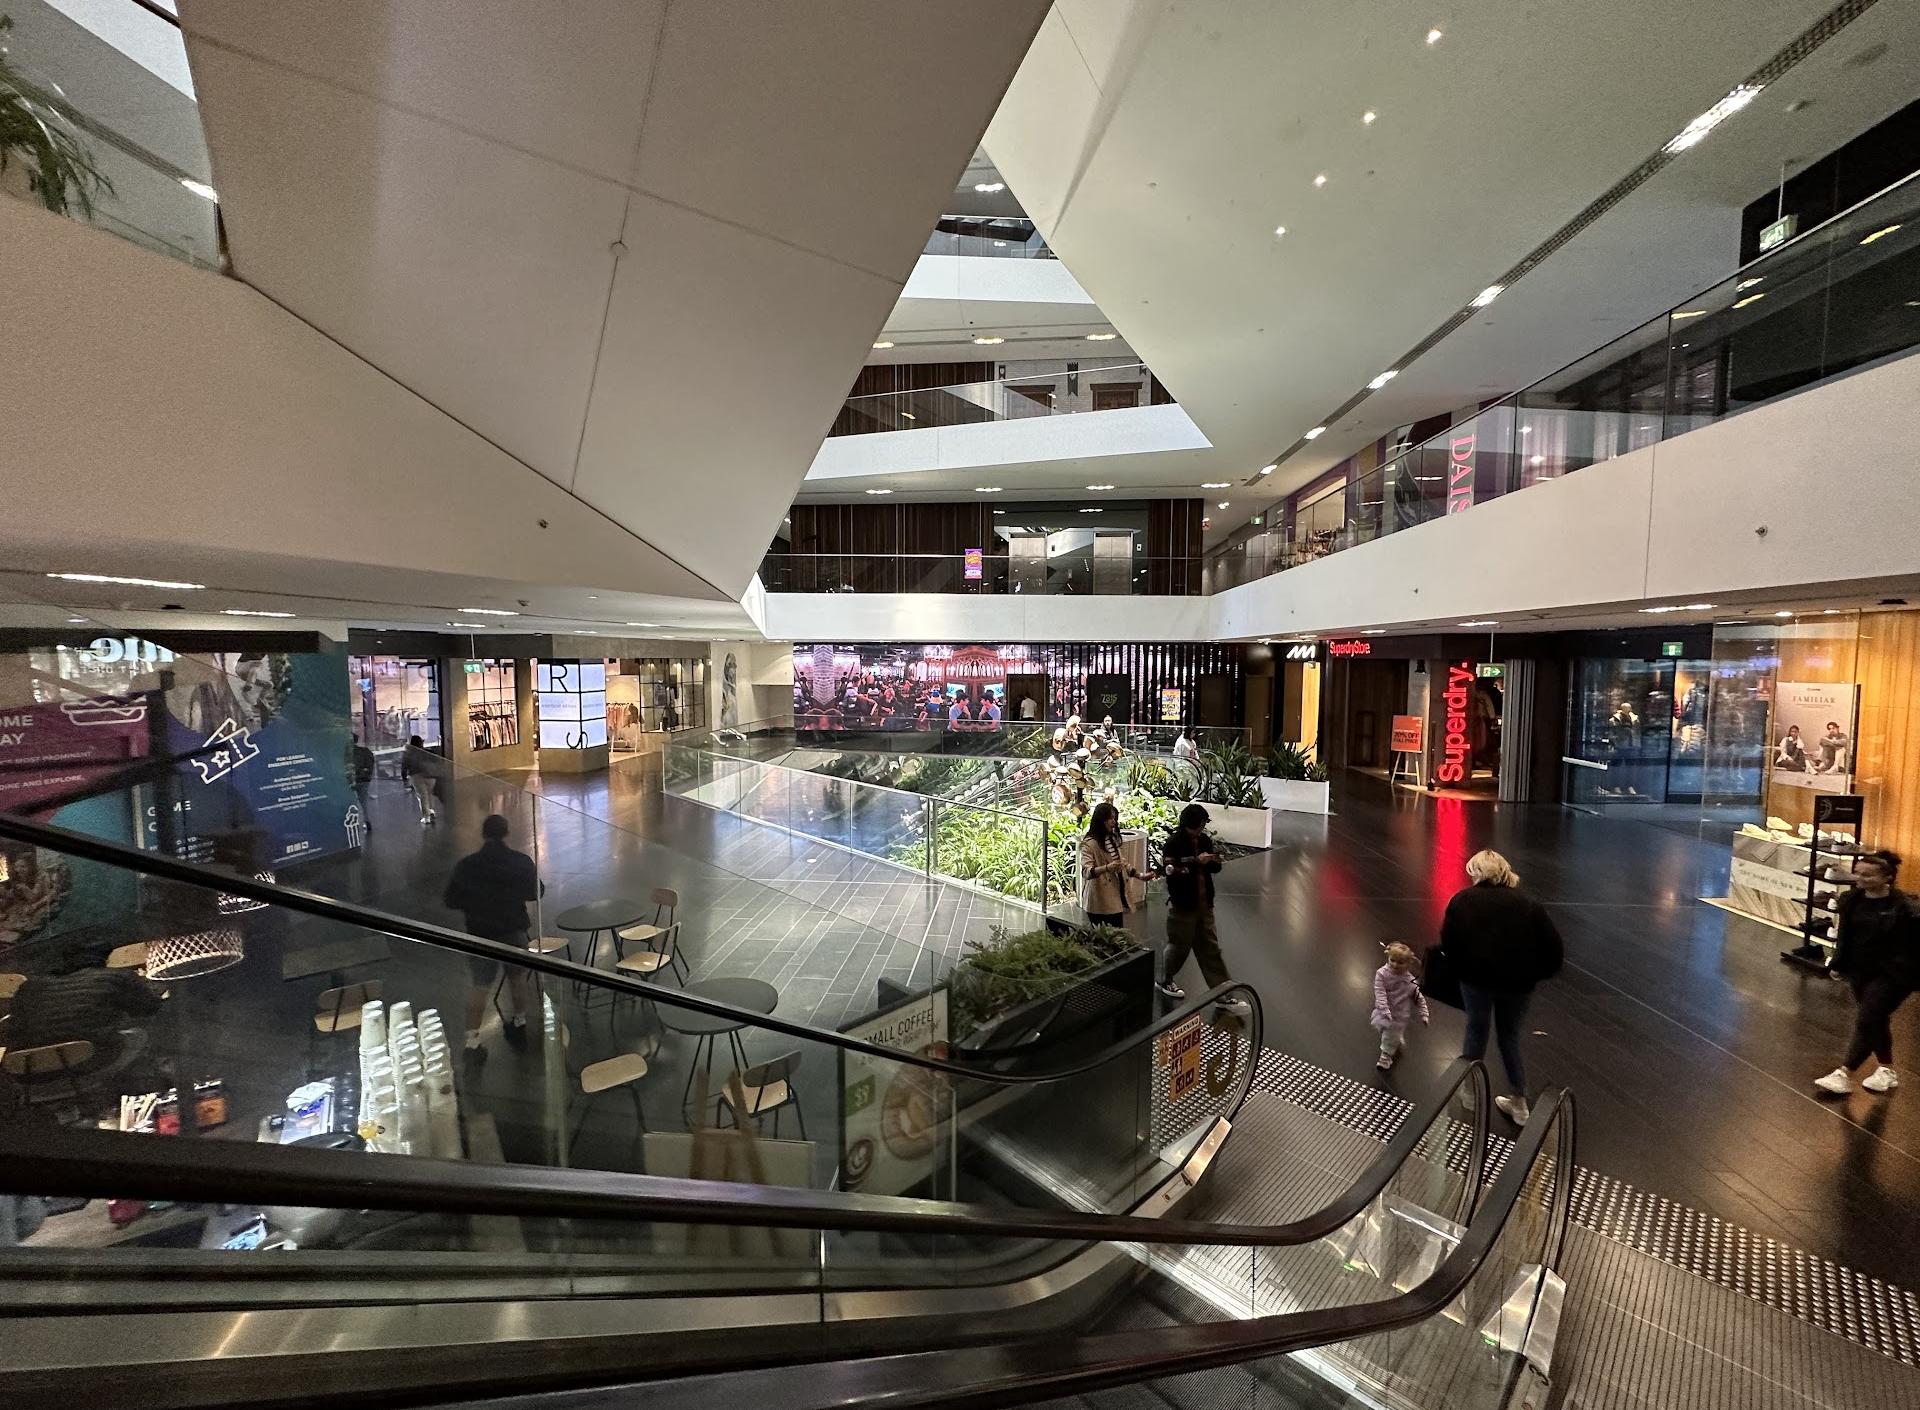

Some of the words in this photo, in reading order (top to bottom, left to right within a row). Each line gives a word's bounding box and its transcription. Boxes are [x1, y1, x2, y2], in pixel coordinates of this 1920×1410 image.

[549, 663, 568, 692] R
[1792, 695, 1837, 704] FAMILIAR
[23, 780, 42, 788] AND
[898, 1009, 934, 1035] COFFEE
[1175, 1018, 1199, 1037] WARNING
